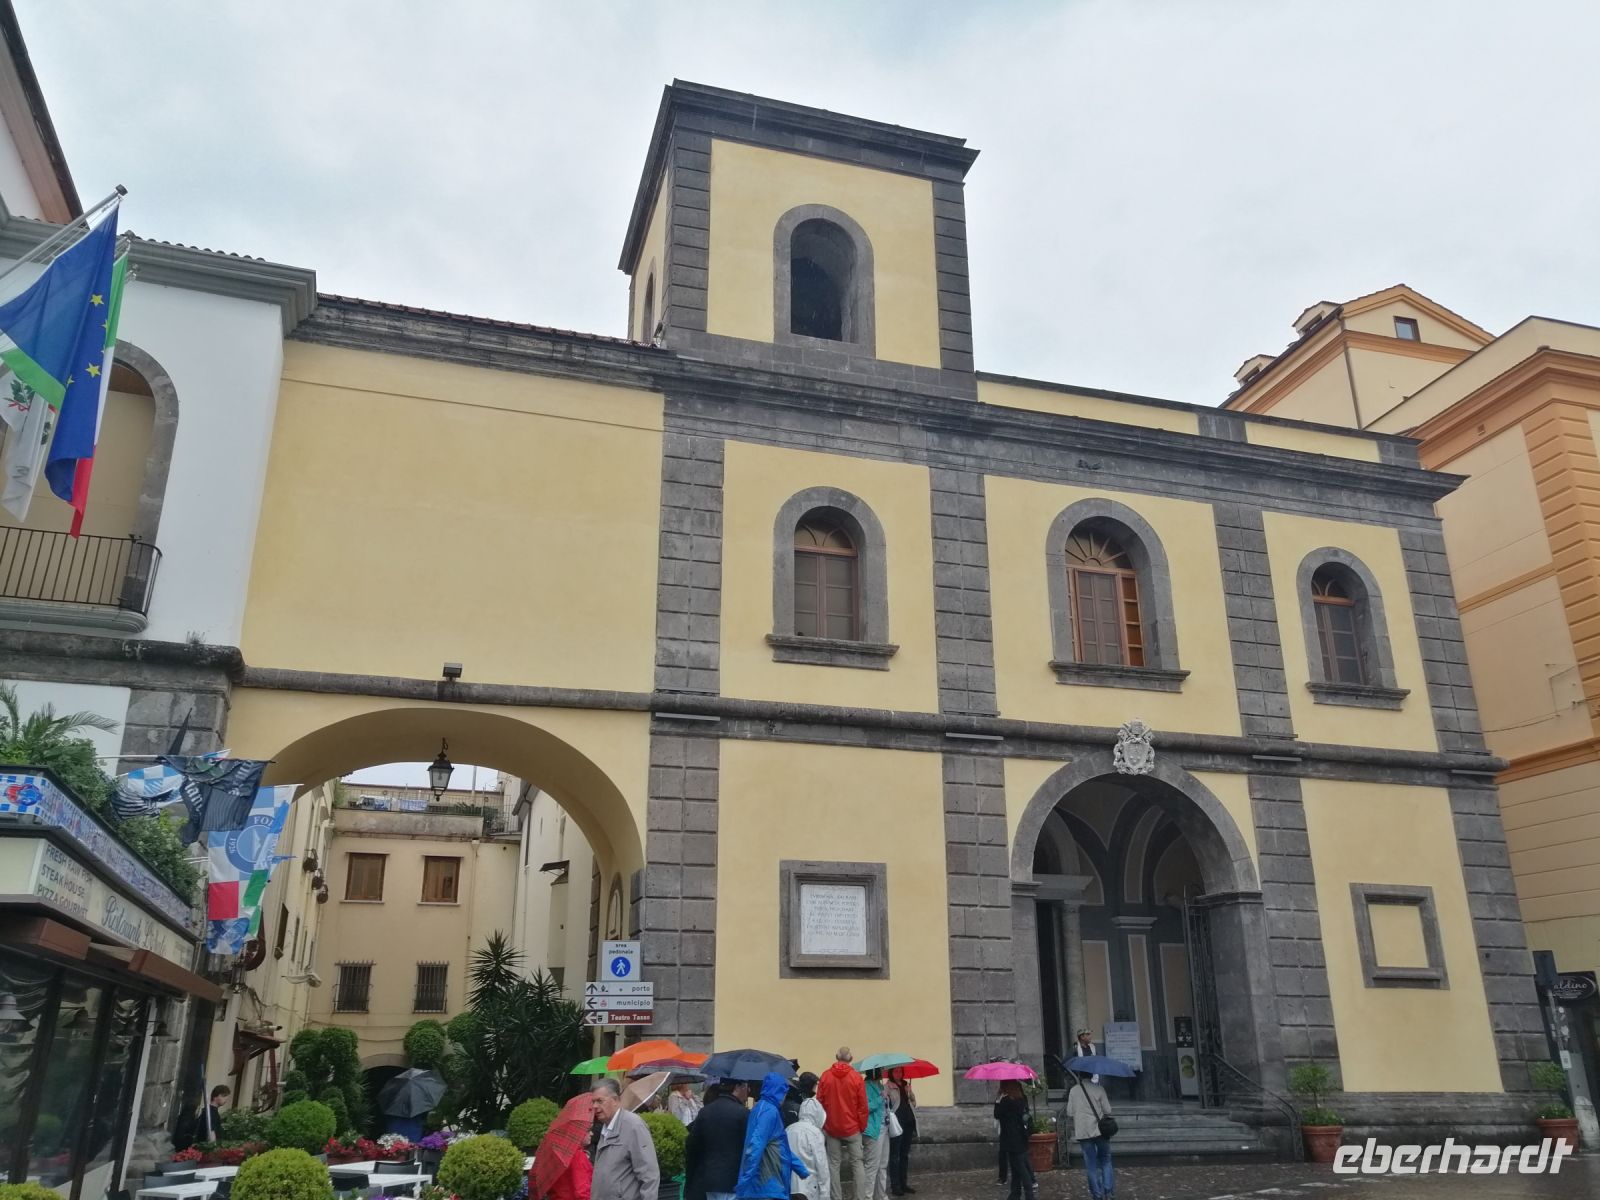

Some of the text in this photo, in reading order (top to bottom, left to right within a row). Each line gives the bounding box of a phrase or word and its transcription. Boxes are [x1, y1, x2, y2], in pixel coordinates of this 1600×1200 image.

[46, 845, 66, 866] FRESH
[41, 864, 86, 899] STEAK HOUSE
[37, 884, 59, 905] PIZZA
[631, 985, 651, 993] porto
